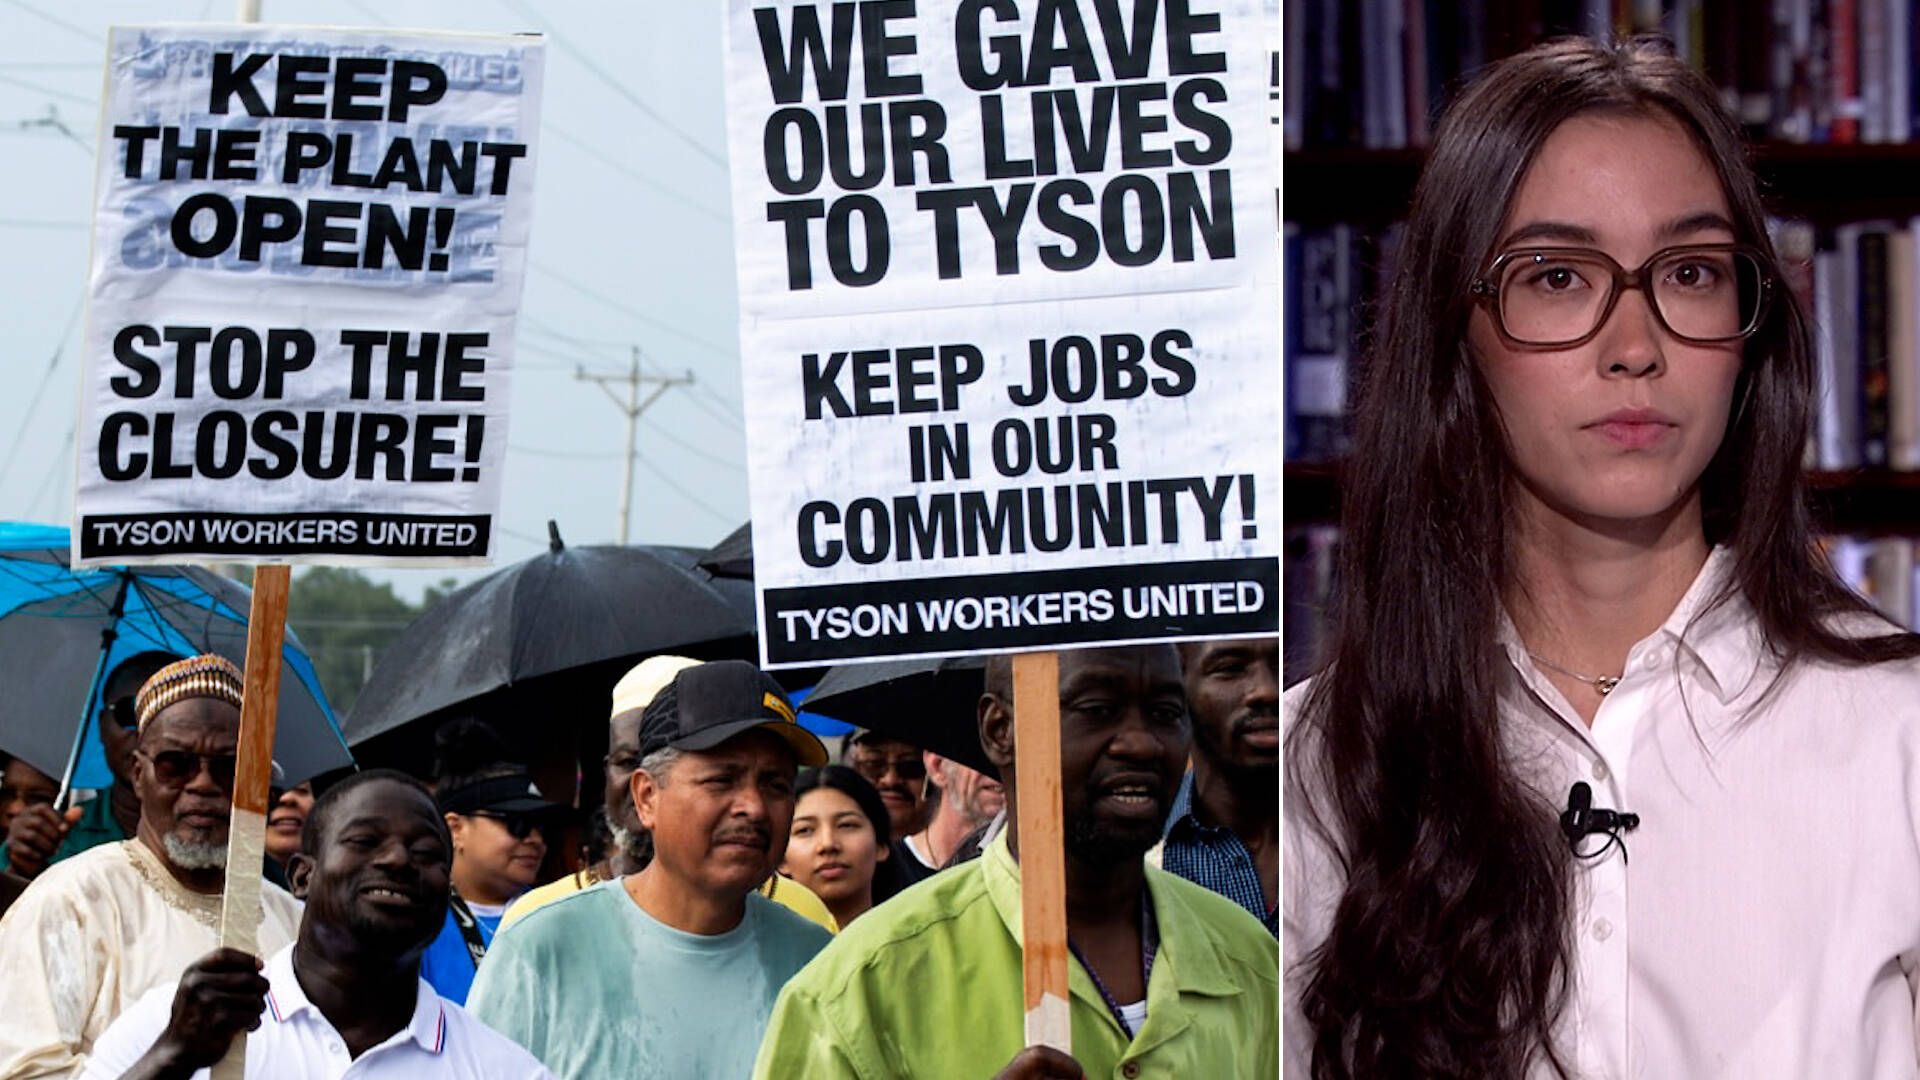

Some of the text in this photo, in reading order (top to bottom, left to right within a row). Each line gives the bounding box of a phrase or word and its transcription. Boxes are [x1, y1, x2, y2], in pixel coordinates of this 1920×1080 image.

[209, 53, 447, 122] KEEP
[753, 0, 923, 105] WE
[955, 0, 1227, 91] GAVE
[113, 125, 261, 181] THE
[283, 132, 527, 195] PLANT
[764, 99, 953, 195] OUR
[979, 78, 1232, 180] LIVES
[170, 193, 455, 271] OPEN!
[767, 194, 890, 291] TO
[916, 169, 1235, 280] TYSON
[110, 324, 490, 401] STOP THE
[802, 329, 1196, 420] KEEP JOBS
[99, 410, 485, 482] CLOSURE!
[908, 413, 1118, 483] IN OUR
[93, 519, 476, 547] TYSON WORKERS UNITED
[798, 474, 1257, 568] COMMUNITY!
[778, 580, 1264, 643] TYSON WORKERS UNITED
